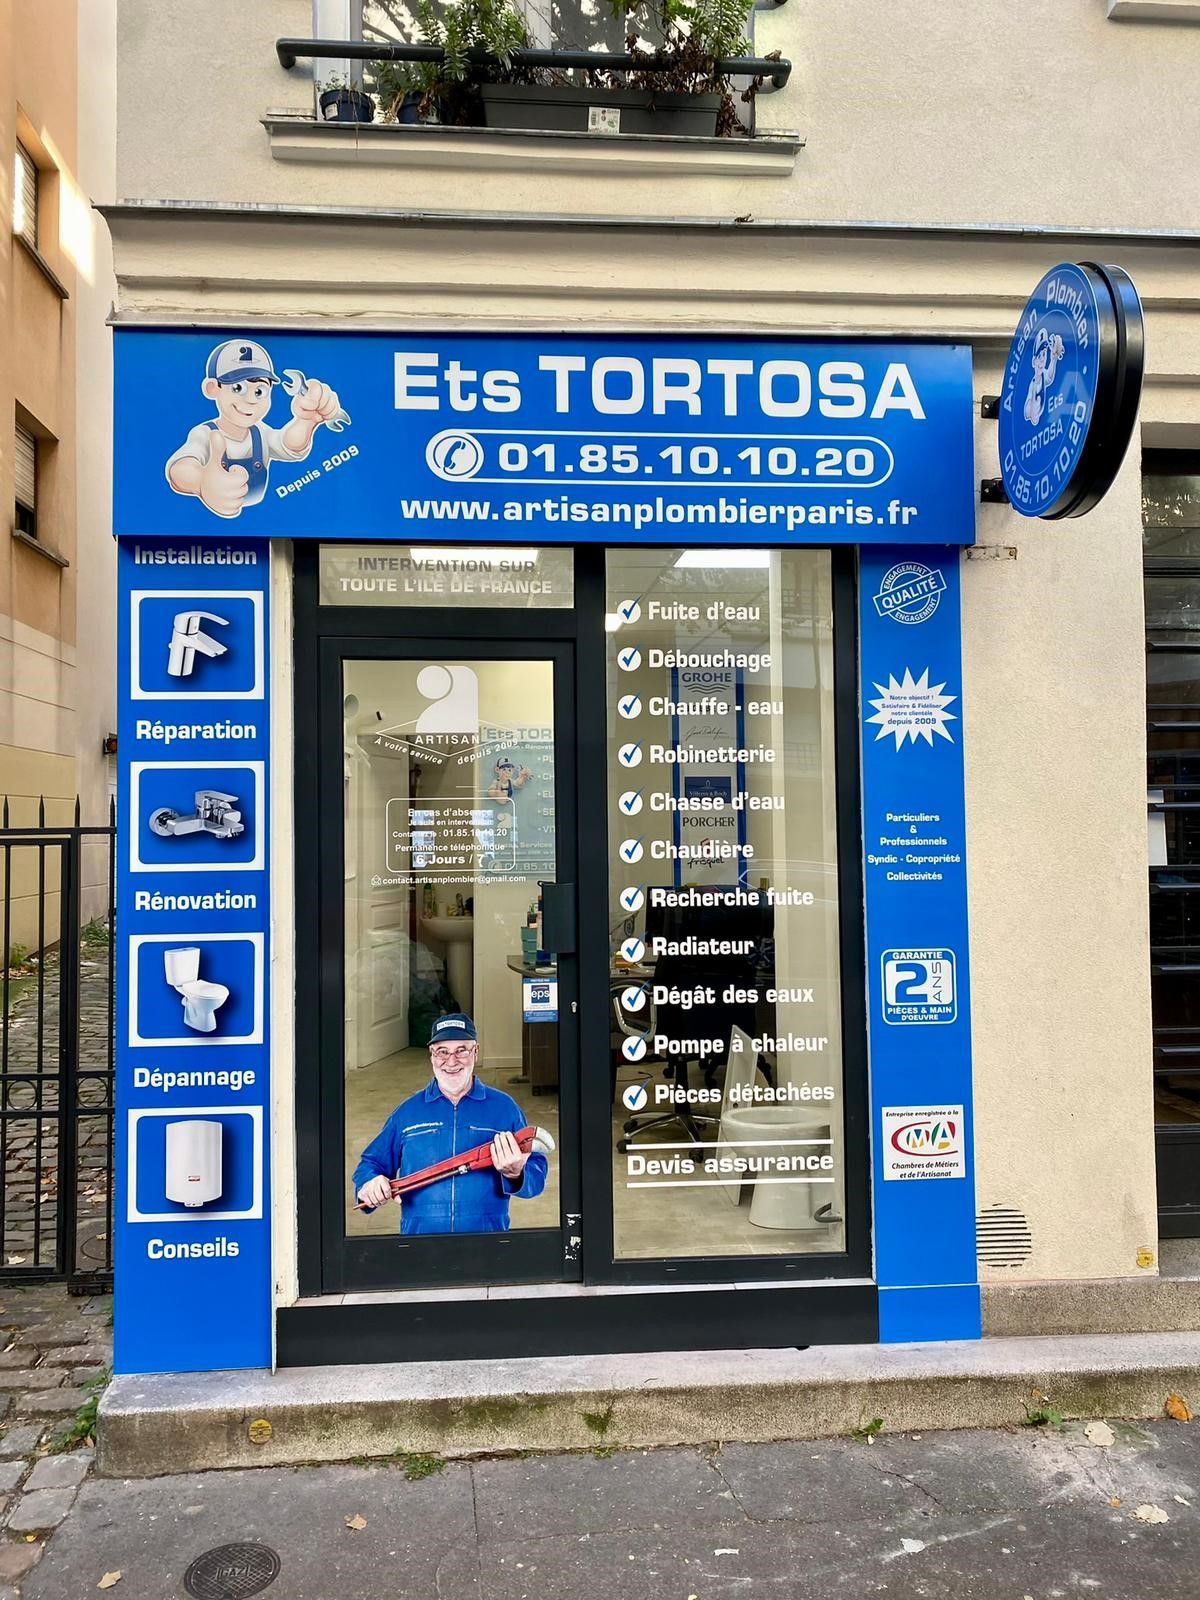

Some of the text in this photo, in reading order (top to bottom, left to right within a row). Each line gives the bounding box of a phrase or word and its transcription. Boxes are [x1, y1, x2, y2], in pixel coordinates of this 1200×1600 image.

[1003, 279, 1089, 413] Artisan Plombier
[394, 352, 927, 421] Ets TORTOSA
[1047, 392, 1064, 414] Ets
[1020, 418, 1064, 461] TORTOSA
[498, 443, 874, 477] 01.85.10.10.20
[275, 445, 360, 498] Depuis 2009
[401, 495, 918, 531] www.artisanplombierparis.fr
[134, 545, 257, 565] Installation
[358, 557, 535, 573] INTERVENTION SUR
[340, 578, 397, 592] TOUTE
[451, 581, 474, 593] DE
[481, 581, 552, 594] FRANCE
[883, 564, 928, 590] ENGAGEMENT
[881, 574, 938, 609] QUALITÉ
[648, 601, 760, 620] Fuite d'eau
[895, 598, 937, 622] ENGAGEMENT
[649, 649, 772, 672] Débouchage
[681, 672, 732, 682] GROHE
[650, 697, 729, 716] Chauffe
[748, 701, 784, 716] eau
[135, 720, 257, 744] Réparation
[887, 718, 912, 726] depuis
[415, 734, 480, 745] ARTISAN
[384, 740, 408, 754] votre
[410, 749, 443, 765] service
[457, 748, 491, 766] depuis
[494, 738, 518, 753] 2009
[650, 744, 776, 764] Robinetterie
[650, 791, 785, 811] Chasse d'eau
[682, 816, 735, 828] PORCHER
[886, 813, 940, 822] Particuliers
[910, 825, 917, 834] &
[395, 844, 449, 852] Permanence
[650, 839, 754, 859] Chaudière
[880, 837, 948, 846] Professionnels
[416, 855, 425, 864] 6
[428, 855, 465, 864] Jours
[867, 854, 898, 865] Syndic
[905, 854, 961, 865] Copropriété
[382, 875, 526, 886] contact.artisanplombier@gmail.com
[886, 872, 943, 881] Collectivités
[135, 890, 257, 911] Rénovation
[651, 886, 814, 907] Recherche fuite
[652, 936, 755, 956] Radiateur
[892, 951, 943, 960] GARANTIE
[895, 962, 942, 1003] 2 ANS
[531, 989, 550, 1000] eps
[653, 984, 814, 1009] Dégât des eaux
[887, 1006, 918, 1014] PIÈCES
[929, 1006, 952, 1014] MAIN
[654, 1032, 828, 1058] Pompe à chaleur
[133, 1067, 256, 1092] Dépannage
[655, 1081, 835, 1104] Pièces détachées
[627, 1153, 834, 1176] Devis assurance
[891, 1162, 925, 1170] Chambres
[934, 1160, 959, 1168] Métiers
[916, 1170, 952, 1178] l'Artisanat
[147, 1237, 240, 1259] Conseils
